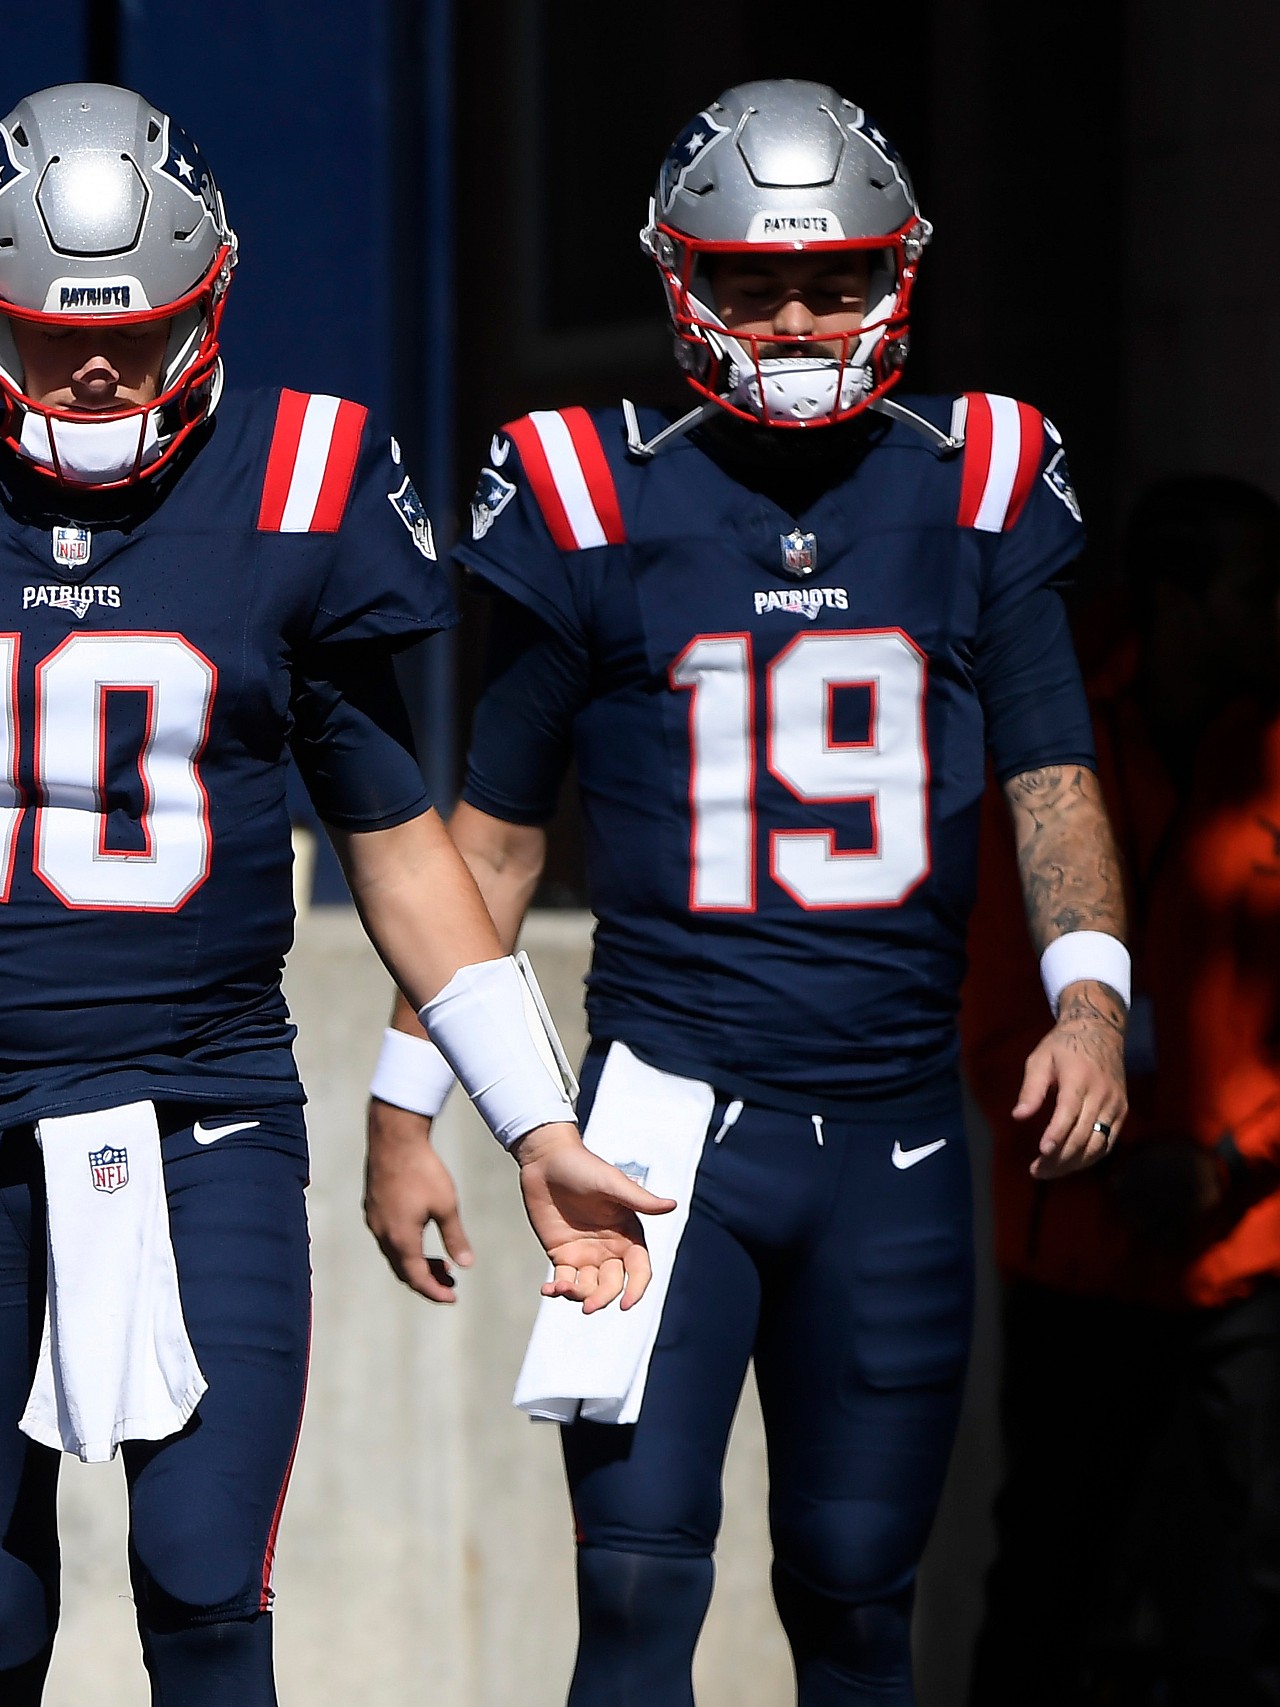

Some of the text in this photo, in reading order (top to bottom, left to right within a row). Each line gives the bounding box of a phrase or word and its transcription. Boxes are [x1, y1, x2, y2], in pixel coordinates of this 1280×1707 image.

[763, 217, 827, 233] PATRIOTS
[59, 286, 130, 310] PATRIOTS
[60, 542, 85, 559] NFL
[22, 585, 121, 610] PATRIOTS
[754, 588, 849, 615] PATRIOTS
[668, 627, 931, 911] 19
[94, 1165, 126, 1188] NFL
